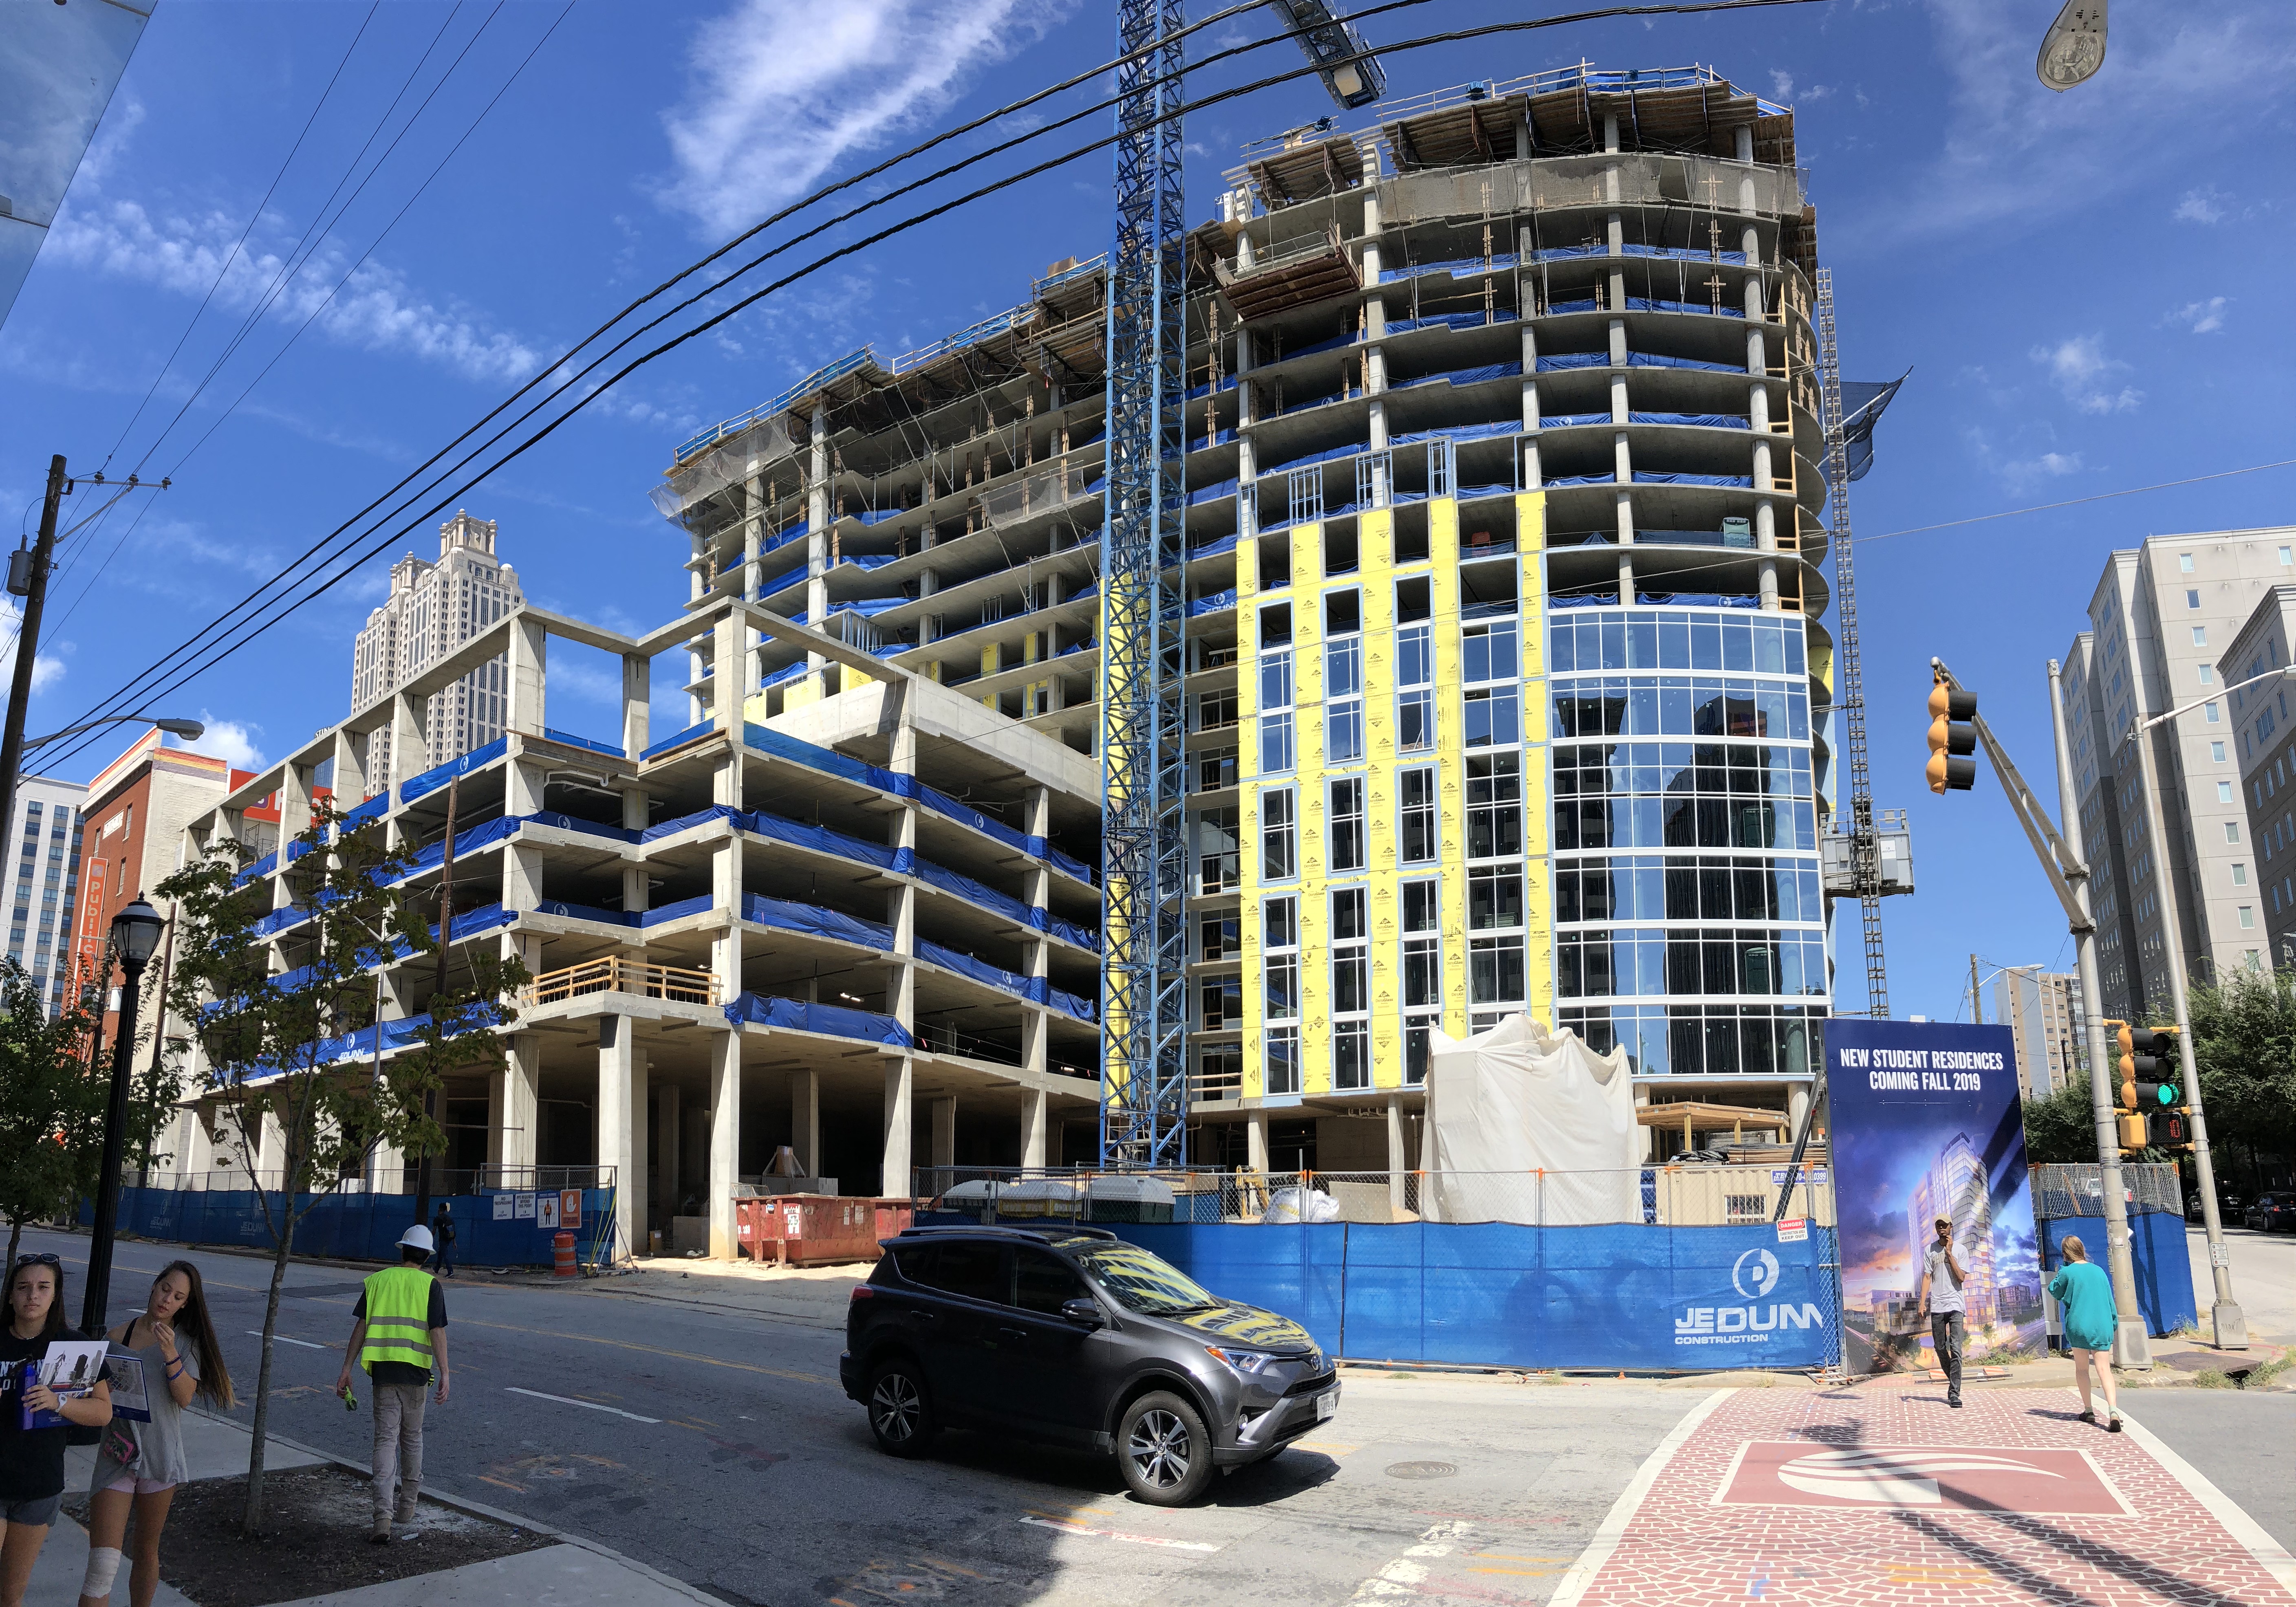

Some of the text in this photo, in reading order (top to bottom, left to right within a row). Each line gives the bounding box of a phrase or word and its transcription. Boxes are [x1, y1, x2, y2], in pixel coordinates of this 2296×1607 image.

[1840, 1048, 2003, 1070] NEW STUDENT RESIDENCES
[1870, 1071, 1981, 1091] COMING FALL 2019
[1675, 1334, 1768, 1345] CONSTRUCTION
